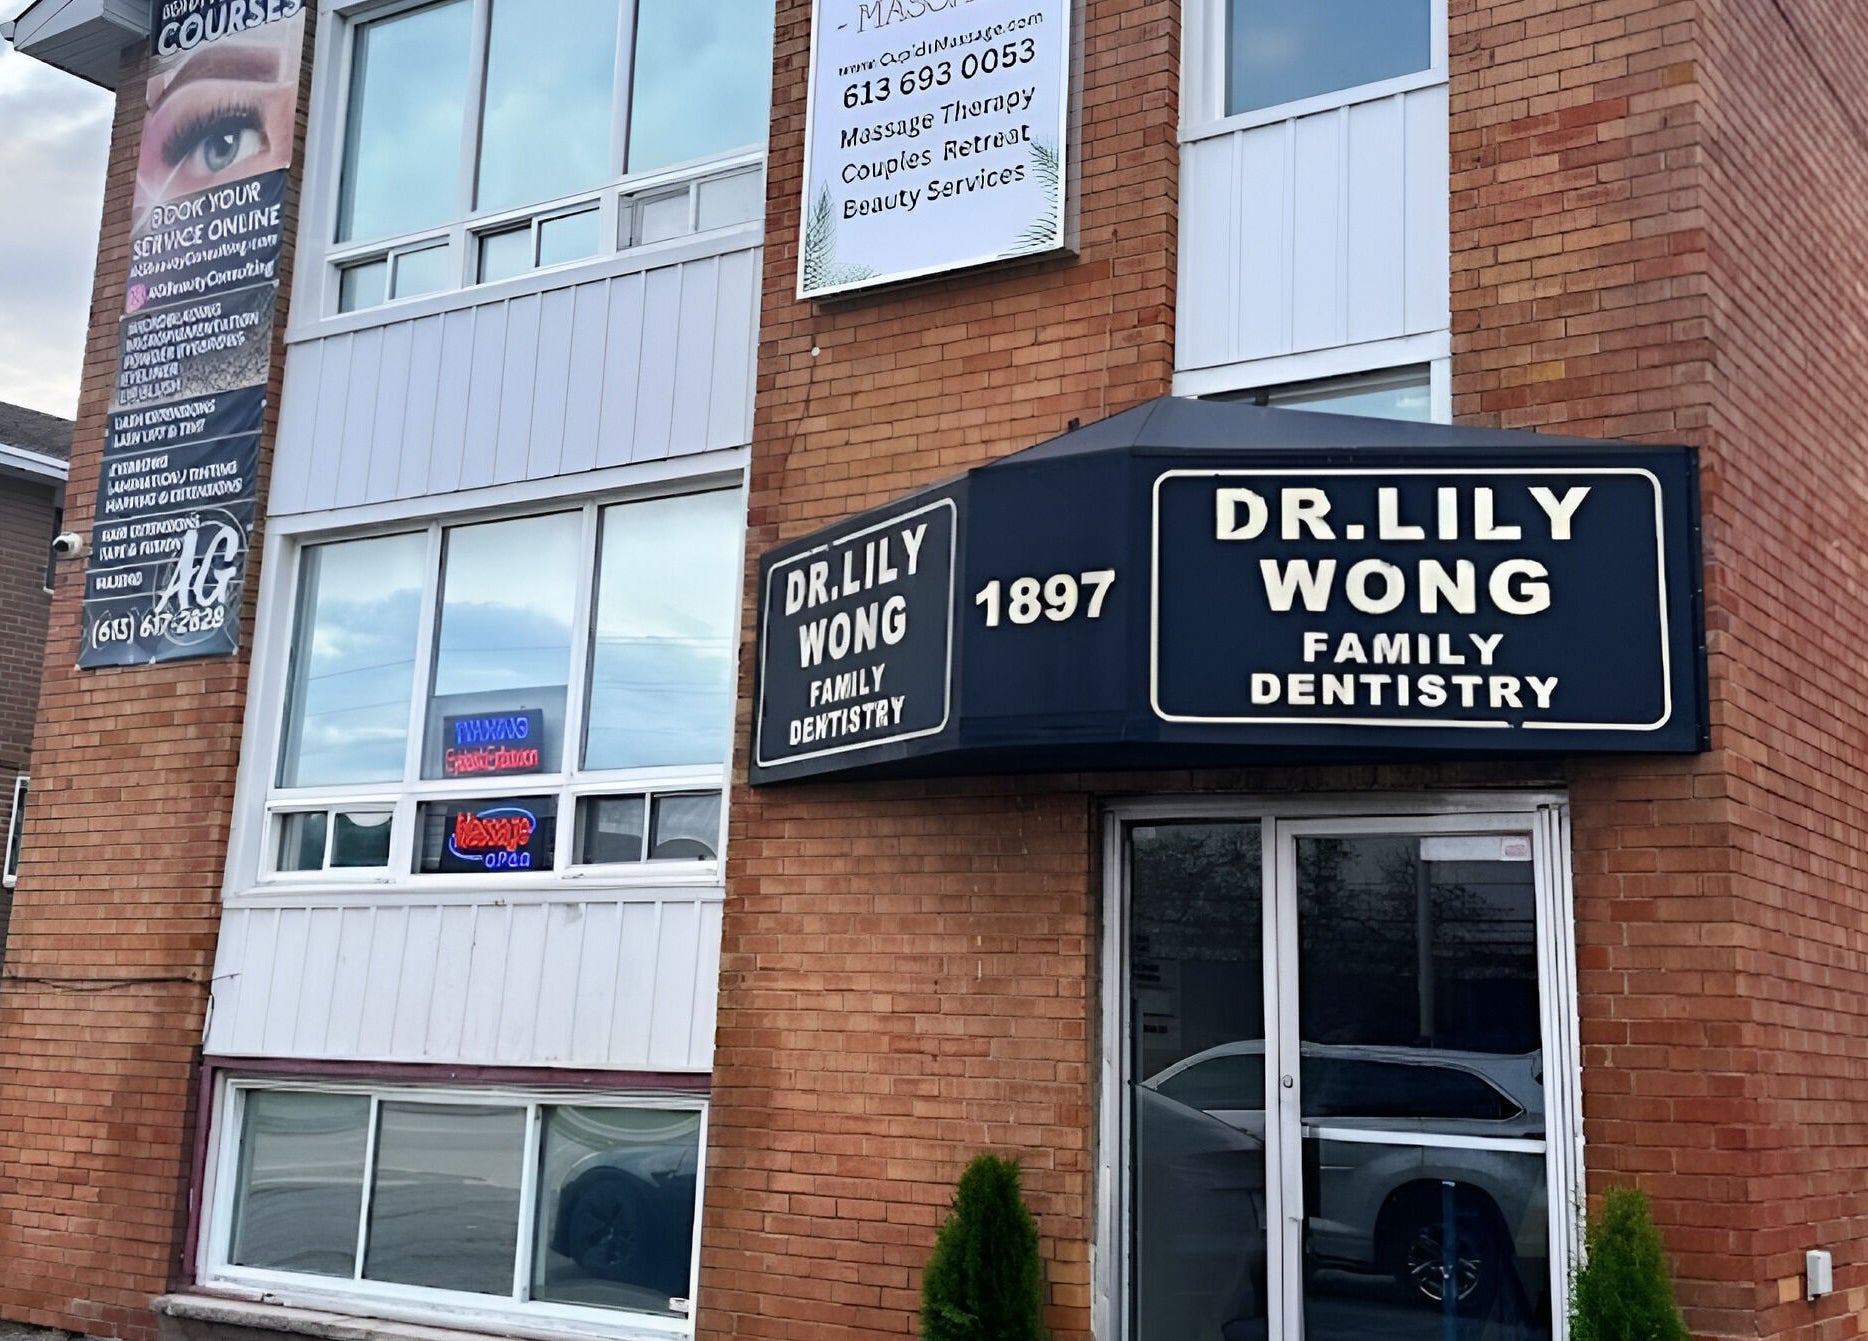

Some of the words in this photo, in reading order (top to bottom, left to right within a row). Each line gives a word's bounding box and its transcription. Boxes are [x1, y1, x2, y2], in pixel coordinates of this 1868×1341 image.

[158, 0, 301, 56] COURSES
[843, 76, 891, 109] 613
[899, 61, 952, 96] 693
[960, 37, 1036, 80] 0053
[840, 113, 935, 149] Massage
[940, 87, 1036, 125] Therapy
[841, 149, 932, 185] Couples
[943, 124, 1032, 162] Retreat
[843, 188, 922, 219] Beauty
[926, 164, 1026, 201] Services
[207, 203, 281, 241] ONLINE
[975, 568, 1117, 628] 1897
[1259, 558, 1551, 615] WONG
[798, 594, 907, 669] WONG
[1303, 631, 1504, 666] FAMILY
[810, 662, 887, 709] FAMILY
[1251, 672, 1559, 709] DENTISTRY
[789, 695, 906, 747] DENTISTRY
